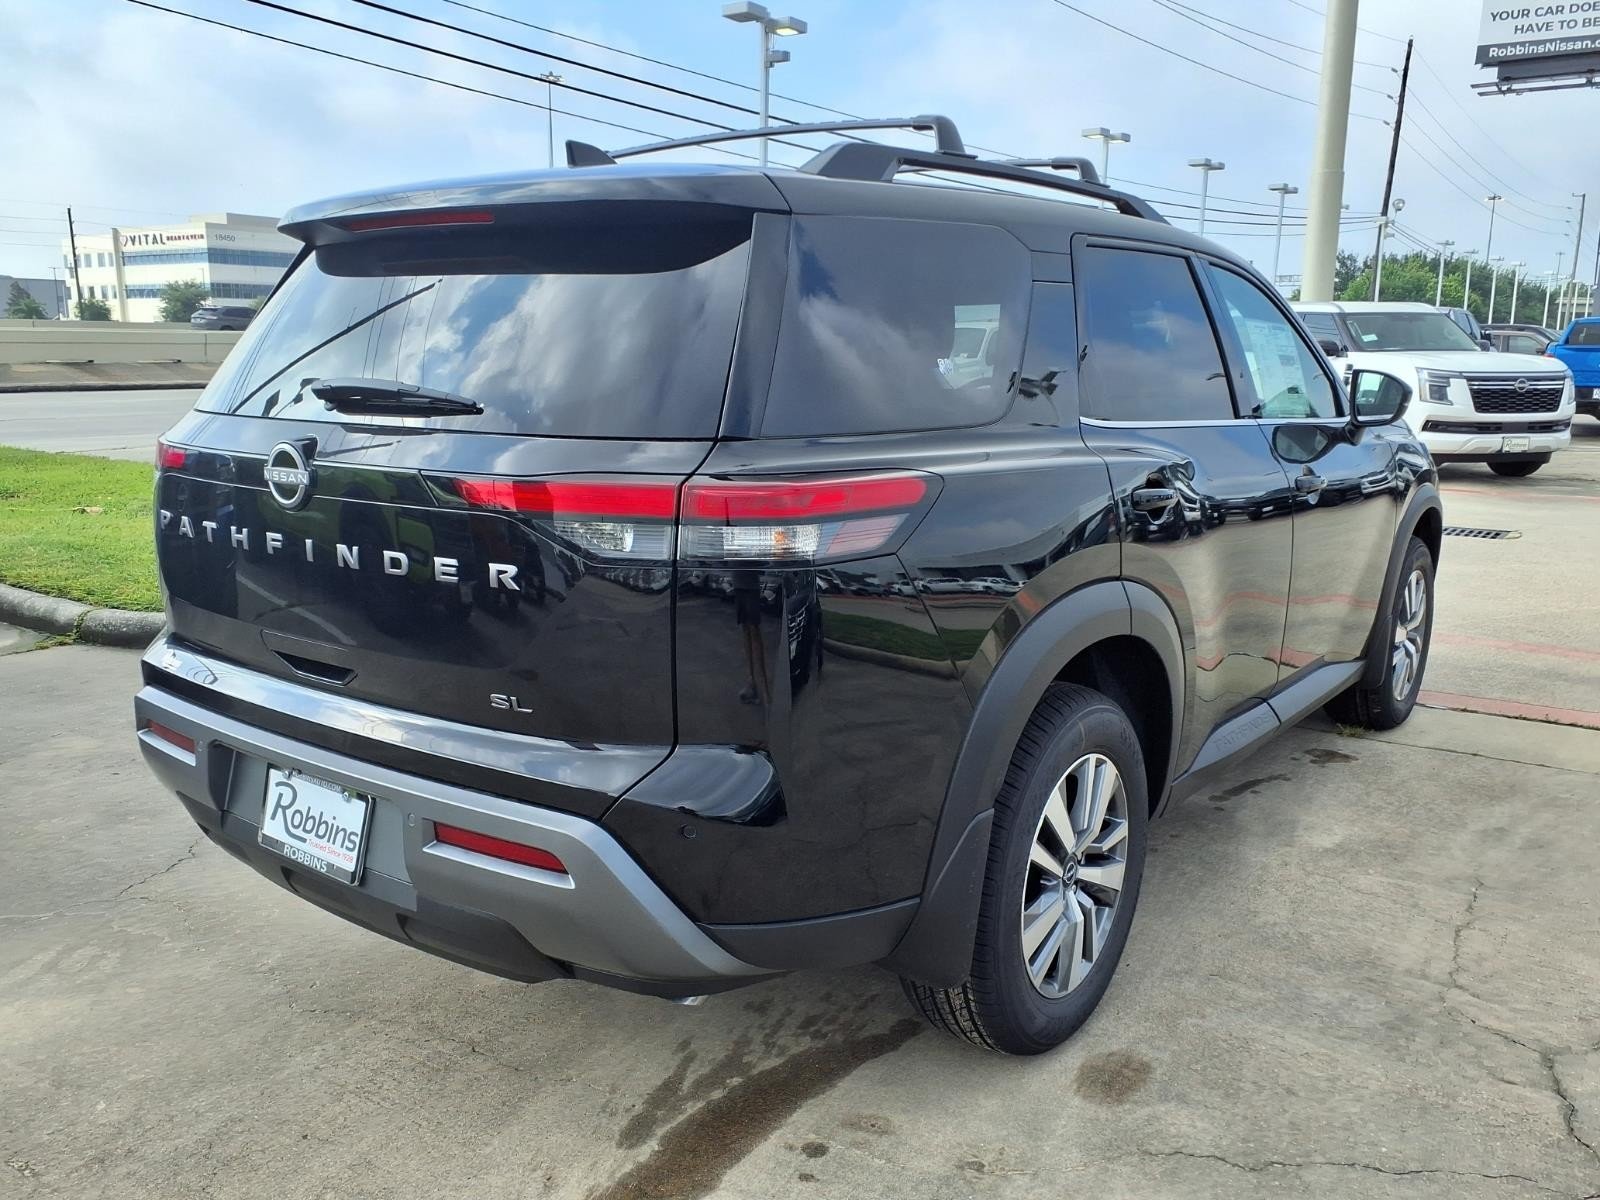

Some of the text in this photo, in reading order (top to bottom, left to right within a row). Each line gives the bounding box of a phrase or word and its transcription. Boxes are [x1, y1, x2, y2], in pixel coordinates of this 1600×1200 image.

[1490, 8, 1530, 22] YOUR
[1534, 5, 1565, 17] CAR
[1514, 21, 1554, 34] HAVE
[1558, 19, 1578, 30] TO
[129, 233, 166, 247] VITAL
[264, 469, 307, 484] NISSAN
[160, 509, 521, 591] PATHFINDER
[489, 693, 533, 713] SL
[270, 781, 359, 853] Robbins
[283, 845, 328, 873] ROBBINS
